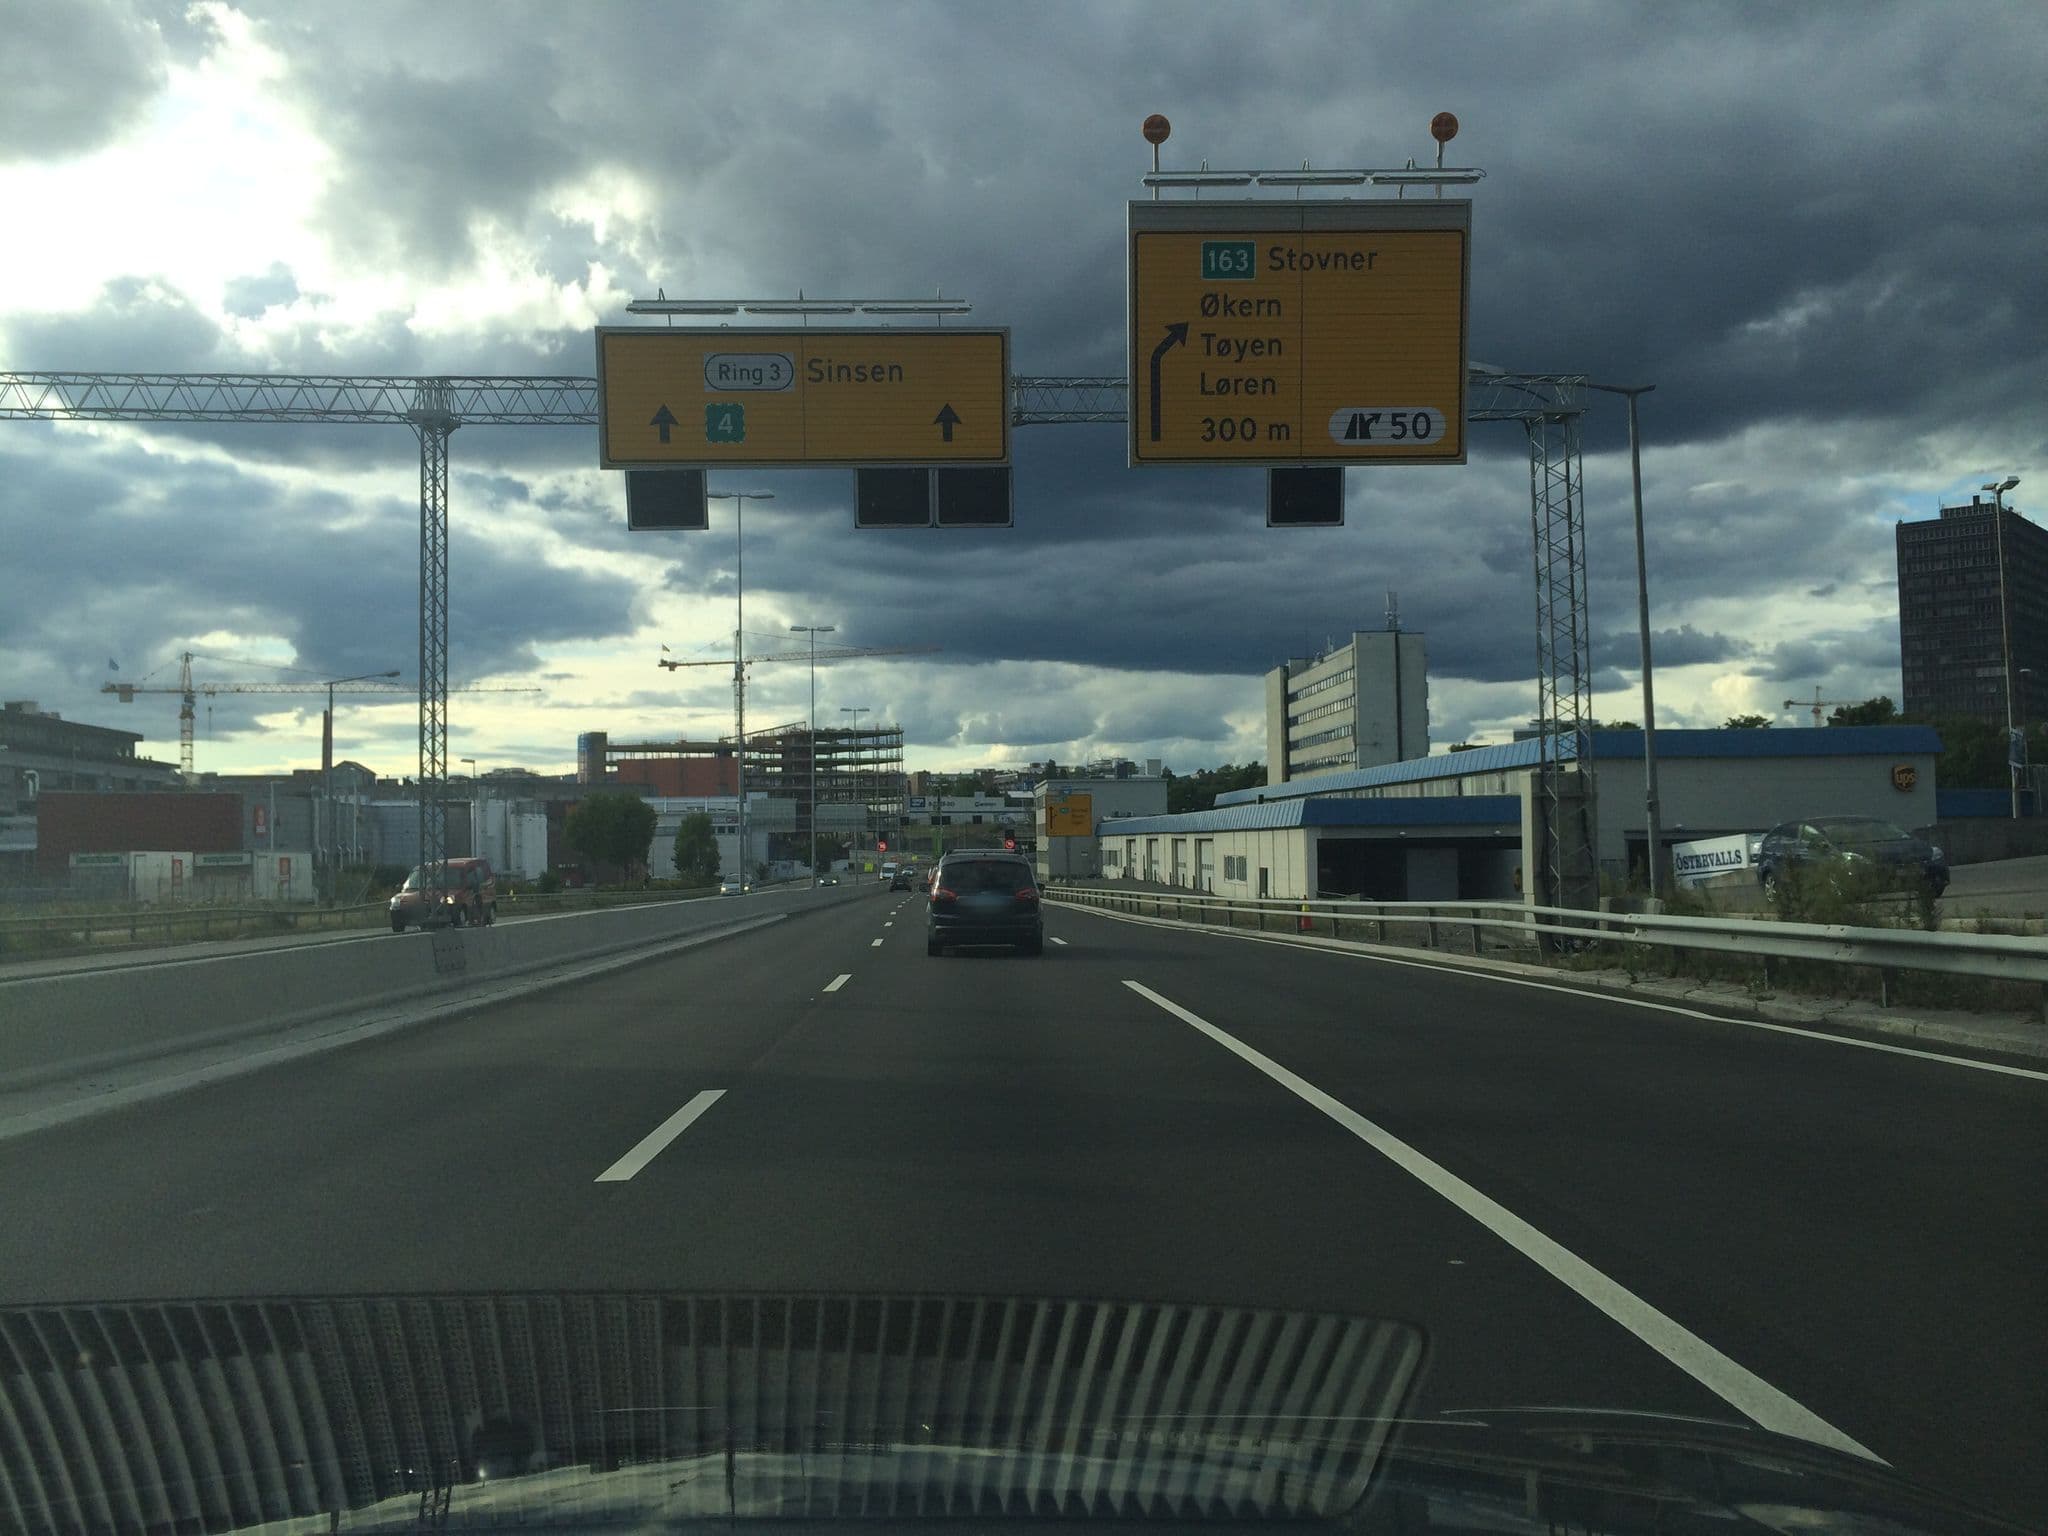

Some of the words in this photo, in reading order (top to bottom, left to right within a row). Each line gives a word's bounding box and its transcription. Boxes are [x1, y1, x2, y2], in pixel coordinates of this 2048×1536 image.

[1207, 249, 1249, 272] 163
[1268, 247, 1379, 272] Stovner
[1200, 293, 1282, 318] Økern
[1200, 333, 1283, 363] Tøyen
[718, 362, 763, 386] Ring
[770, 363, 781, 381] 3
[807, 358, 904, 384] Sinsen
[1200, 372, 1276, 395] Løren
[718, 413, 734, 434] 4
[1201, 417, 1257, 442] 300
[1269, 423, 1291, 441] m
[1391, 412, 1432, 440] 50
